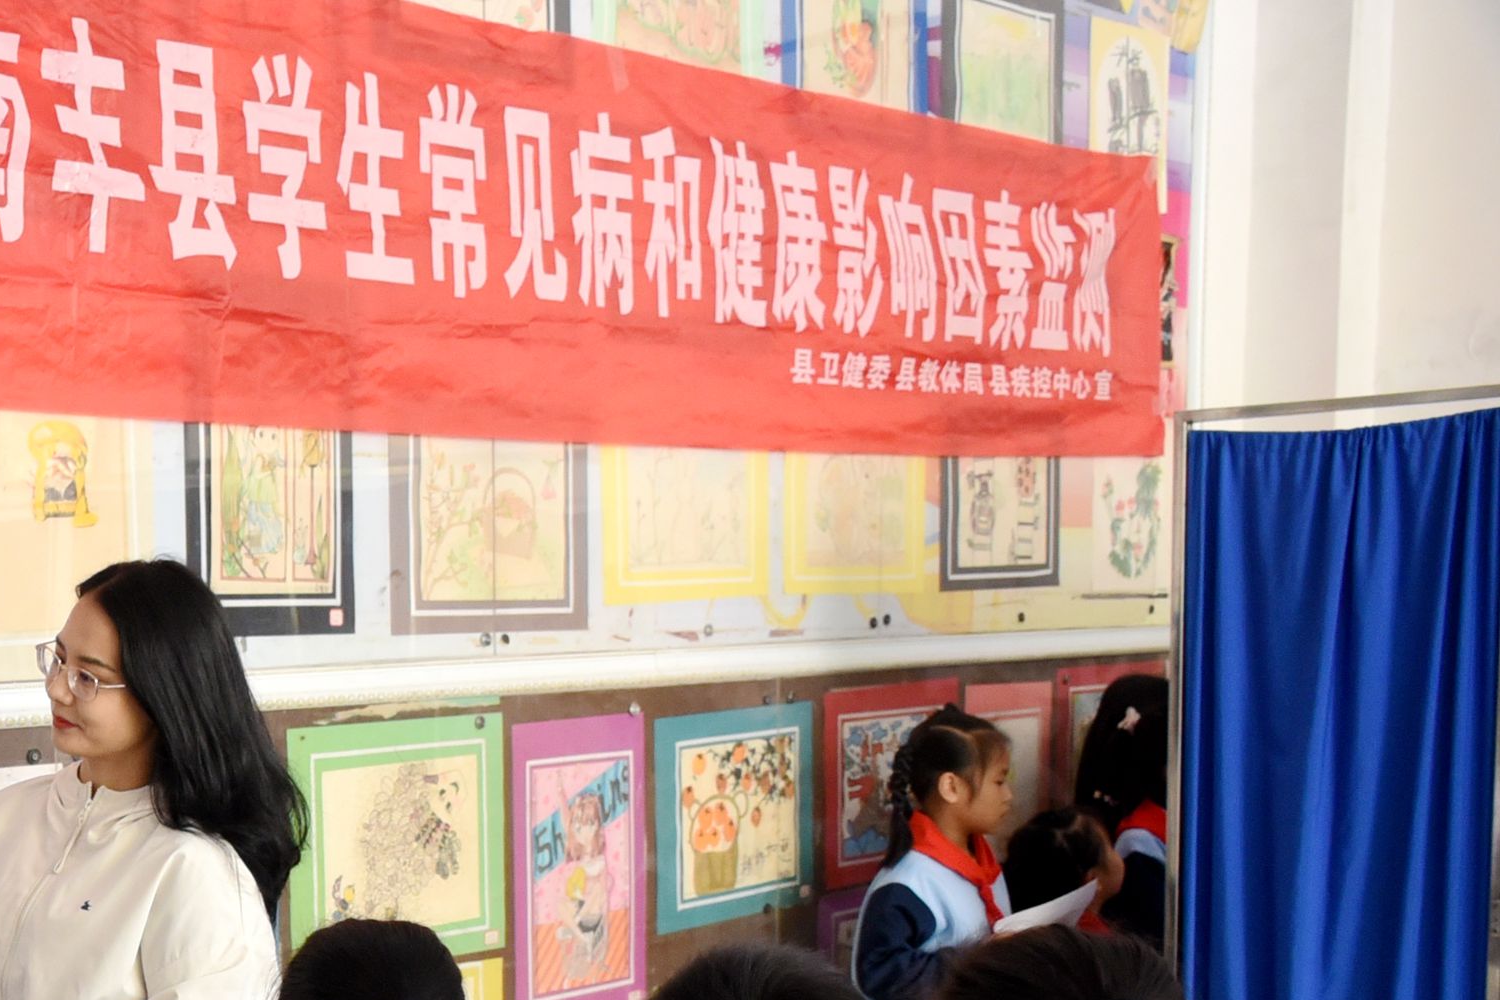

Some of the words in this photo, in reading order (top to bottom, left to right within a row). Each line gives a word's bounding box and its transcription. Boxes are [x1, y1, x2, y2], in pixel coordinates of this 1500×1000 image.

[790, 349, 891, 390] 县卫健委
[895, 357, 985, 395] 县教体局
